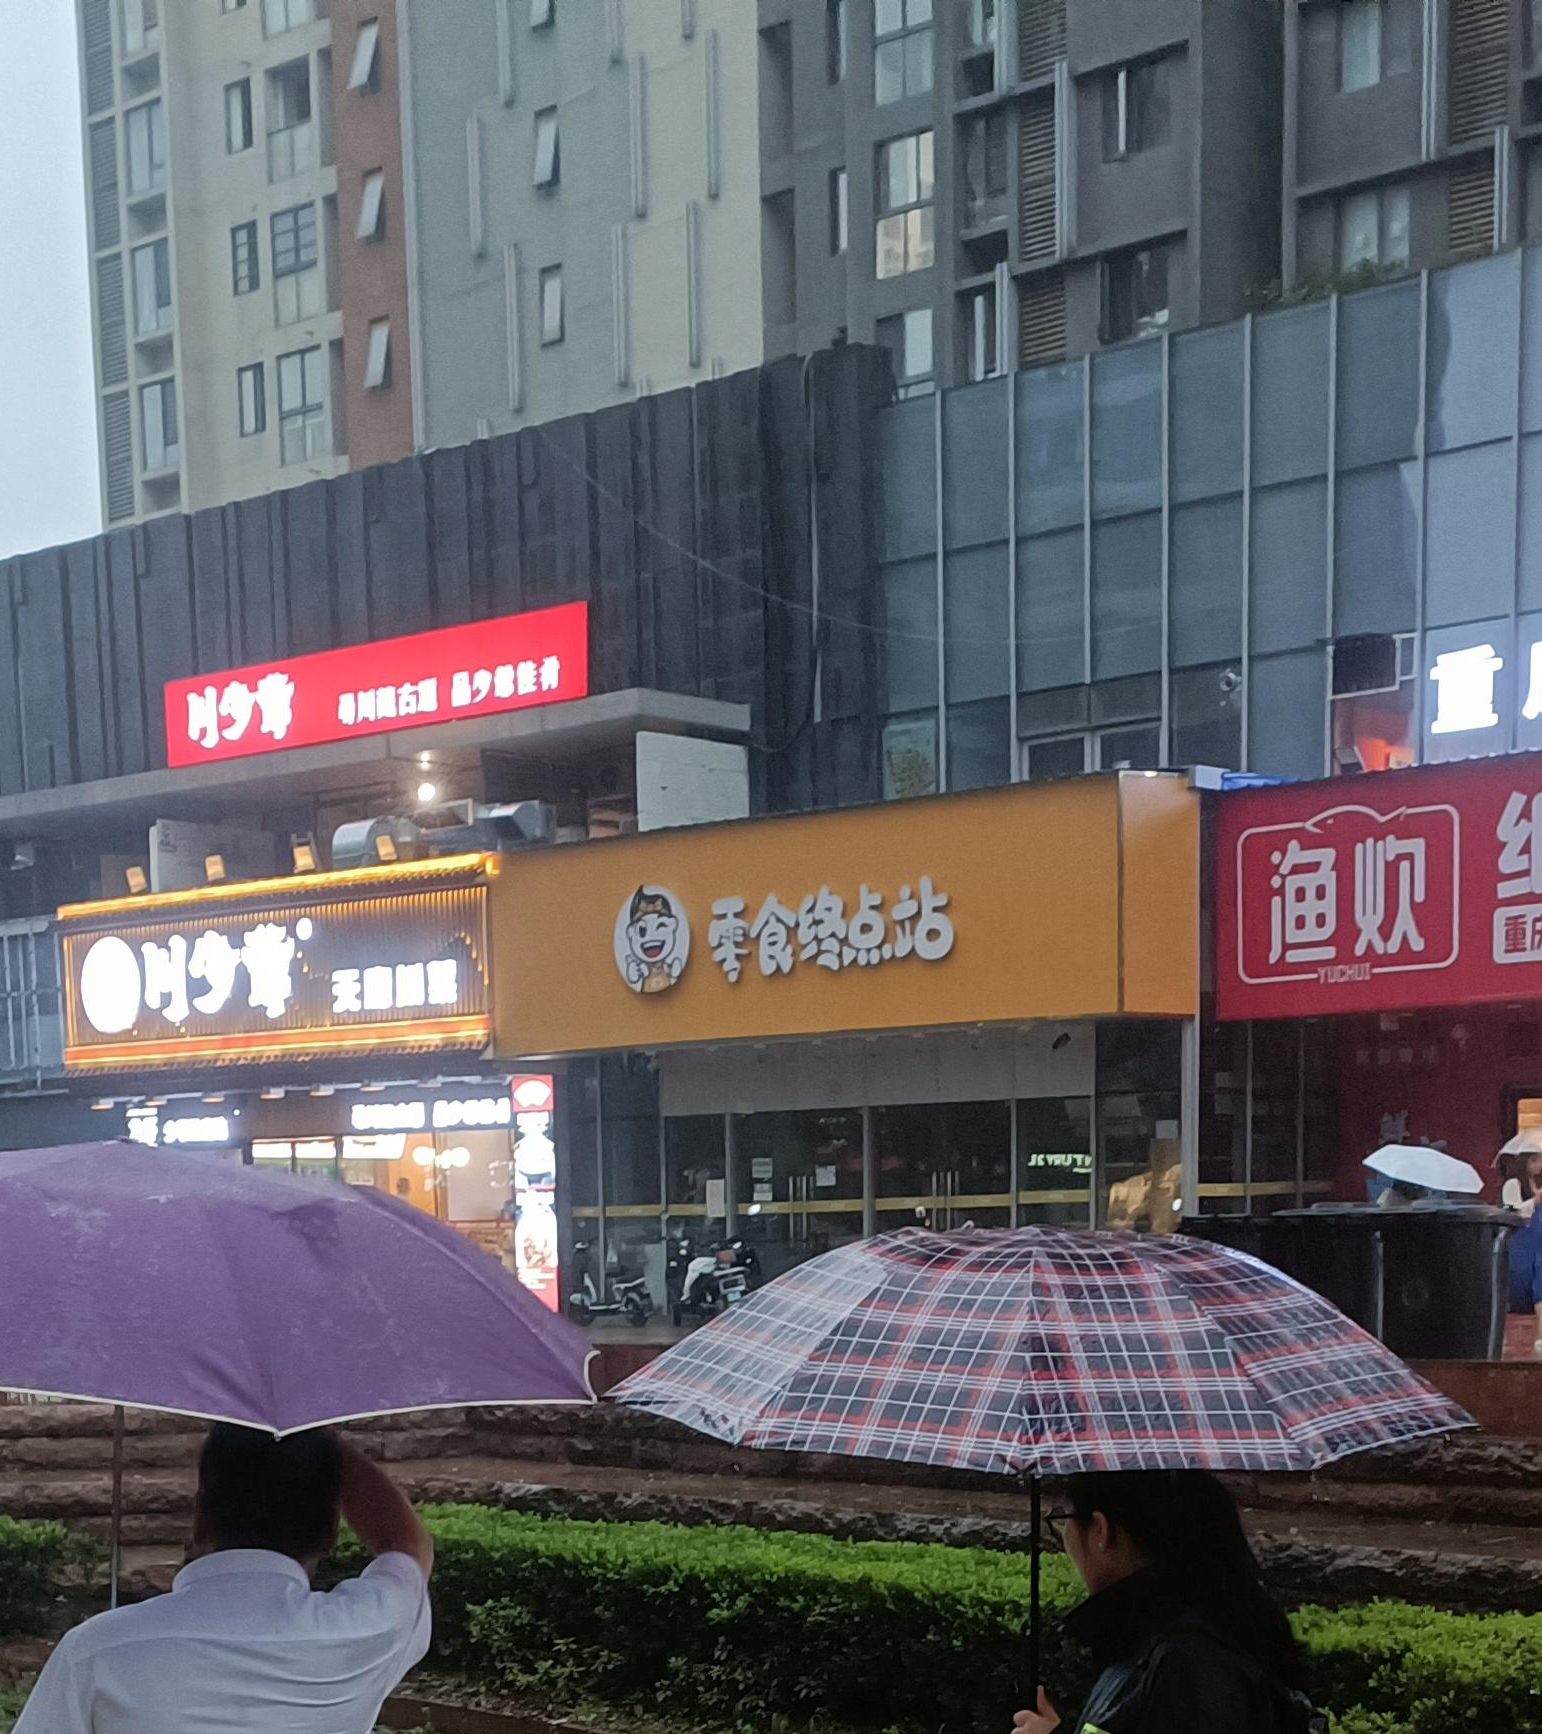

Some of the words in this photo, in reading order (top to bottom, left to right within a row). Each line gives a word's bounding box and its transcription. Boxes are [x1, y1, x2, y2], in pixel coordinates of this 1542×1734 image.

[708, 875, 954, 983] 零食终点站
[1269, 835, 1425, 965] 渔炊
